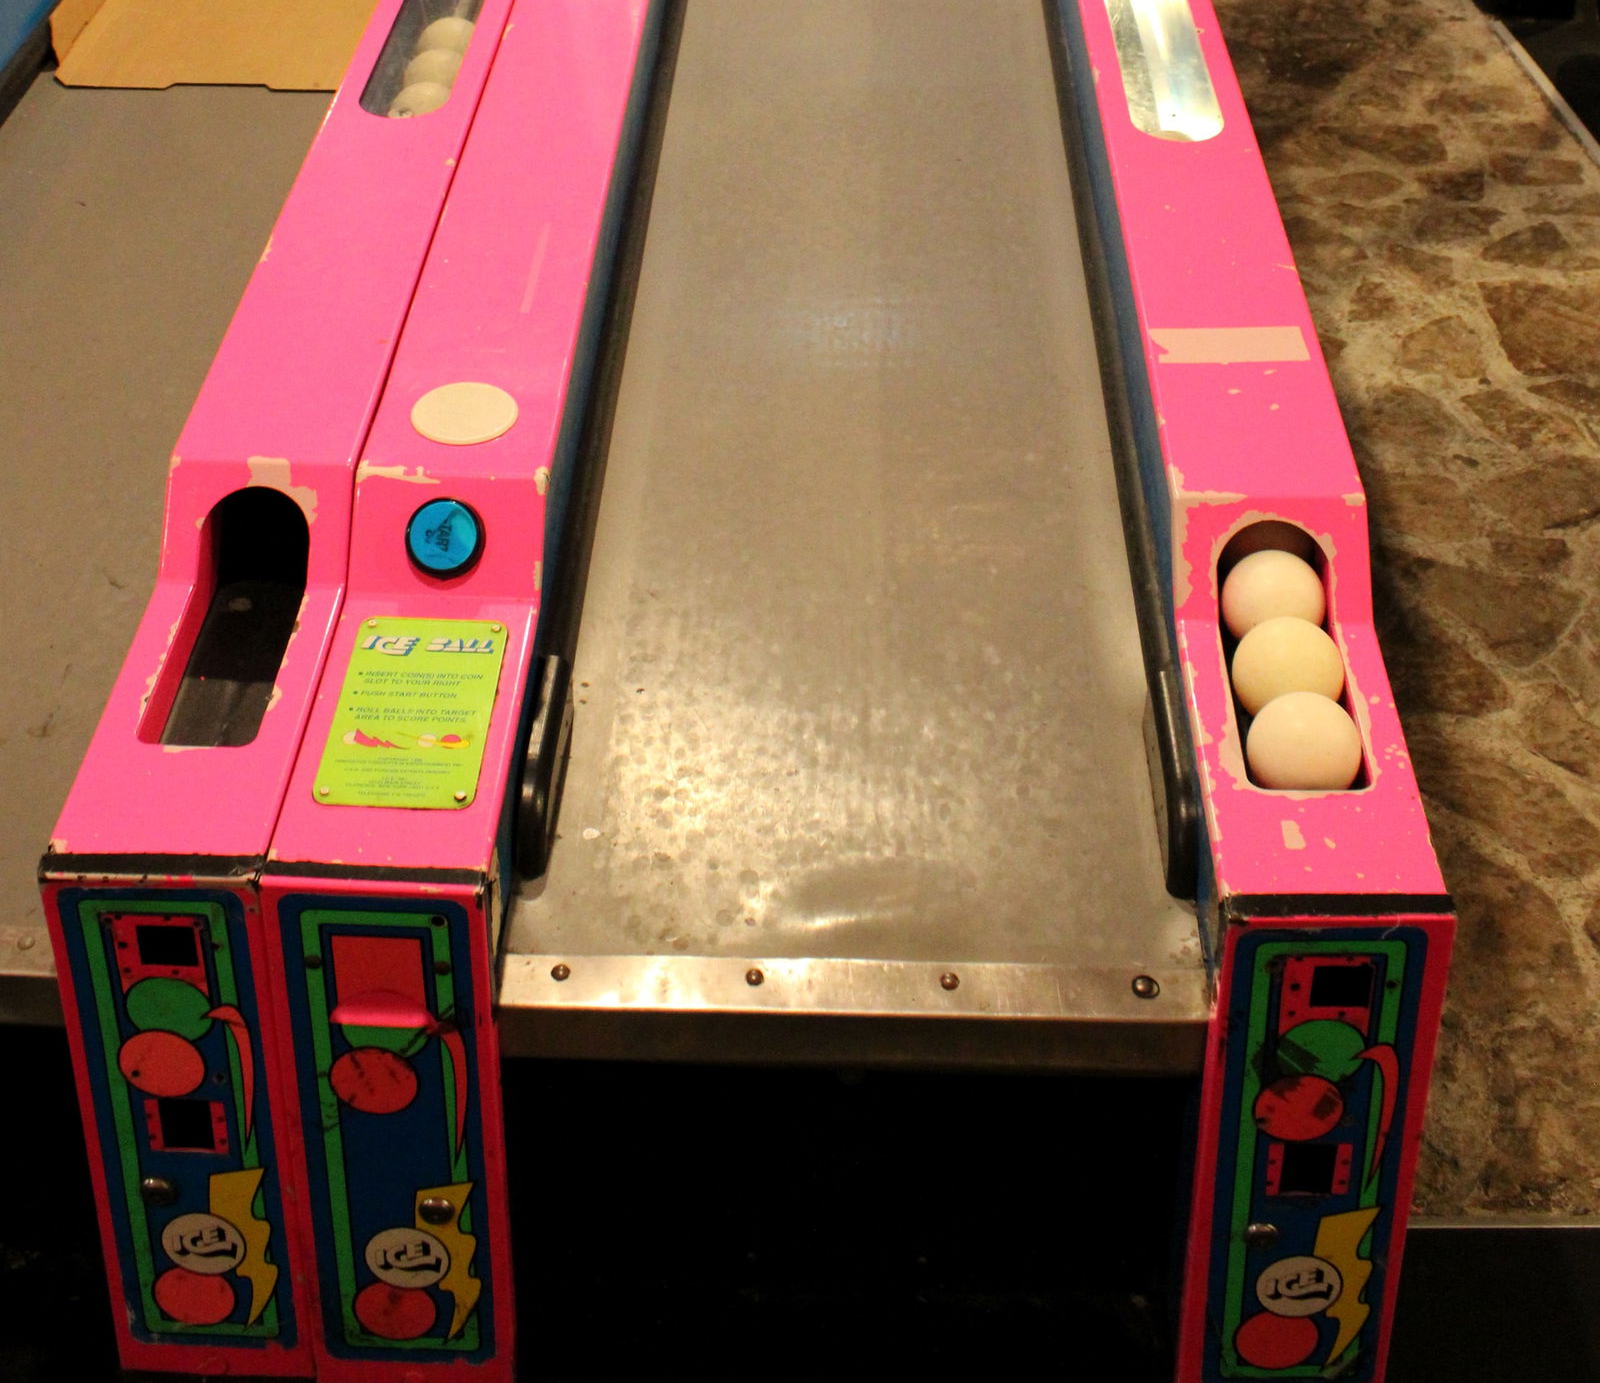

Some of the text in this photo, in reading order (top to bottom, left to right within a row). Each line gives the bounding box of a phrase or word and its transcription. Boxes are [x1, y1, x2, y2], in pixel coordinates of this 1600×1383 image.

[360, 635, 494, 656] ICE BALL
[173, 1225, 239, 1260] ICE
[375, 1239, 444, 1274] ICE
[1267, 1268, 1333, 1300] ICE
